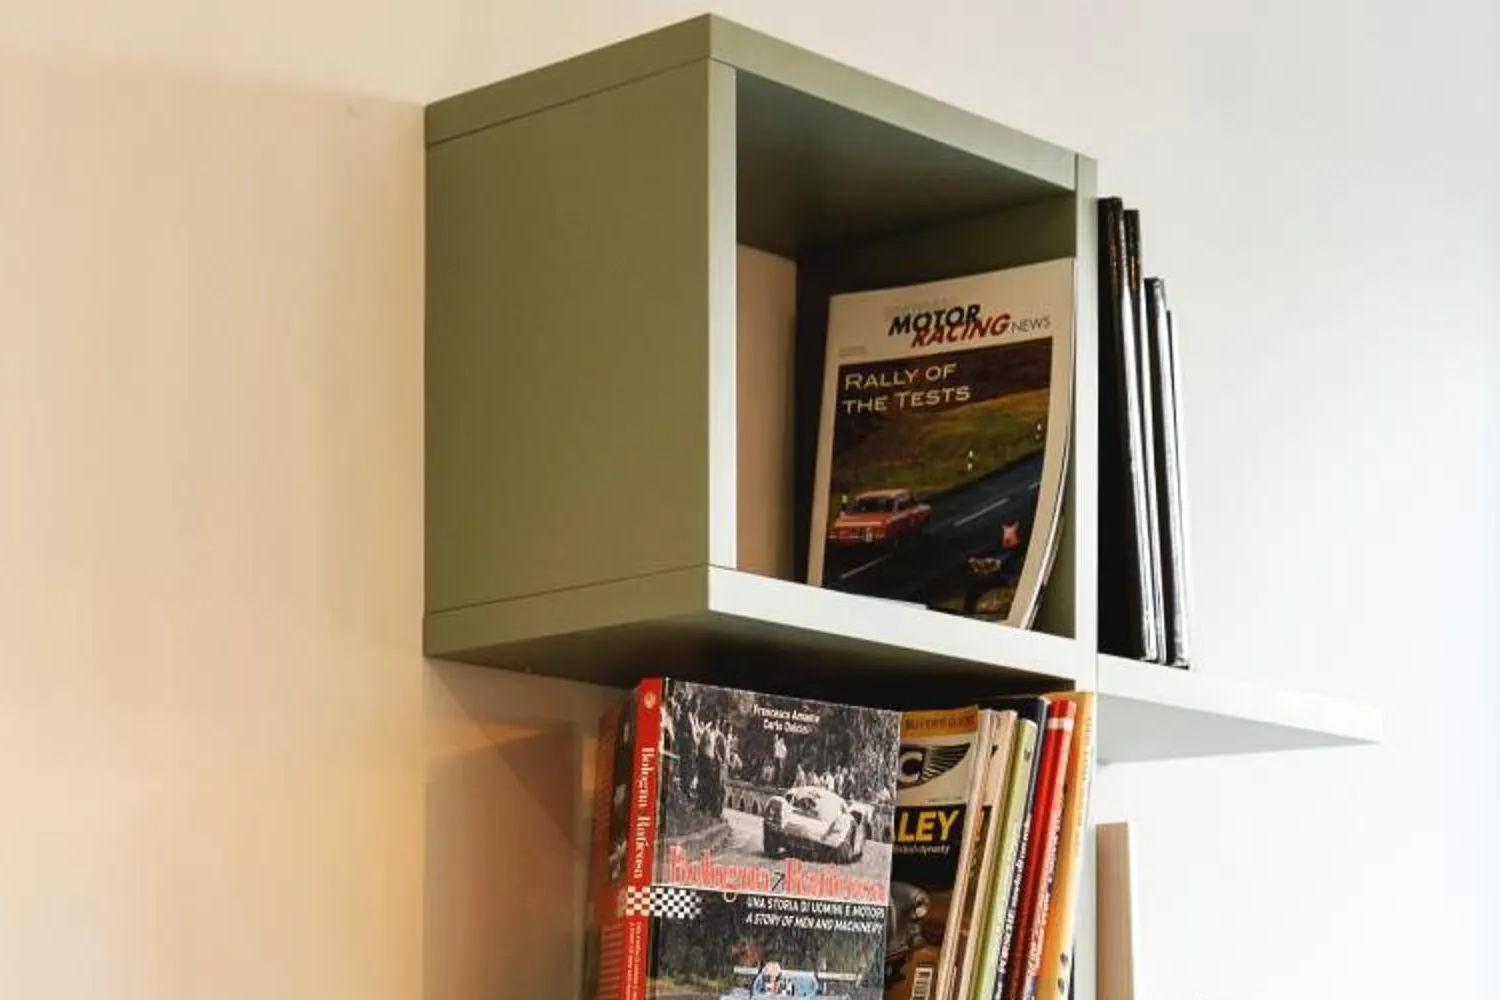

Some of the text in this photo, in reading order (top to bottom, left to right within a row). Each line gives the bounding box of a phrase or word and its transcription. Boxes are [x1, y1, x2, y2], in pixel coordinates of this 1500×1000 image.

[888, 304, 981, 336] MOTOR
[911, 314, 1052, 347] RACING NEWS
[844, 363, 957, 391] RALLY OF
[842, 385, 972, 414] THE TESTS
[638, 747, 655, 807] Bologna
[897, 810, 960, 842] LEY
[745, 912, 884, 934] A STORY OF MEN AND MACHINERY
[747, 897, 885, 919] UNA STORIA DI UOMINI E MOTORI
